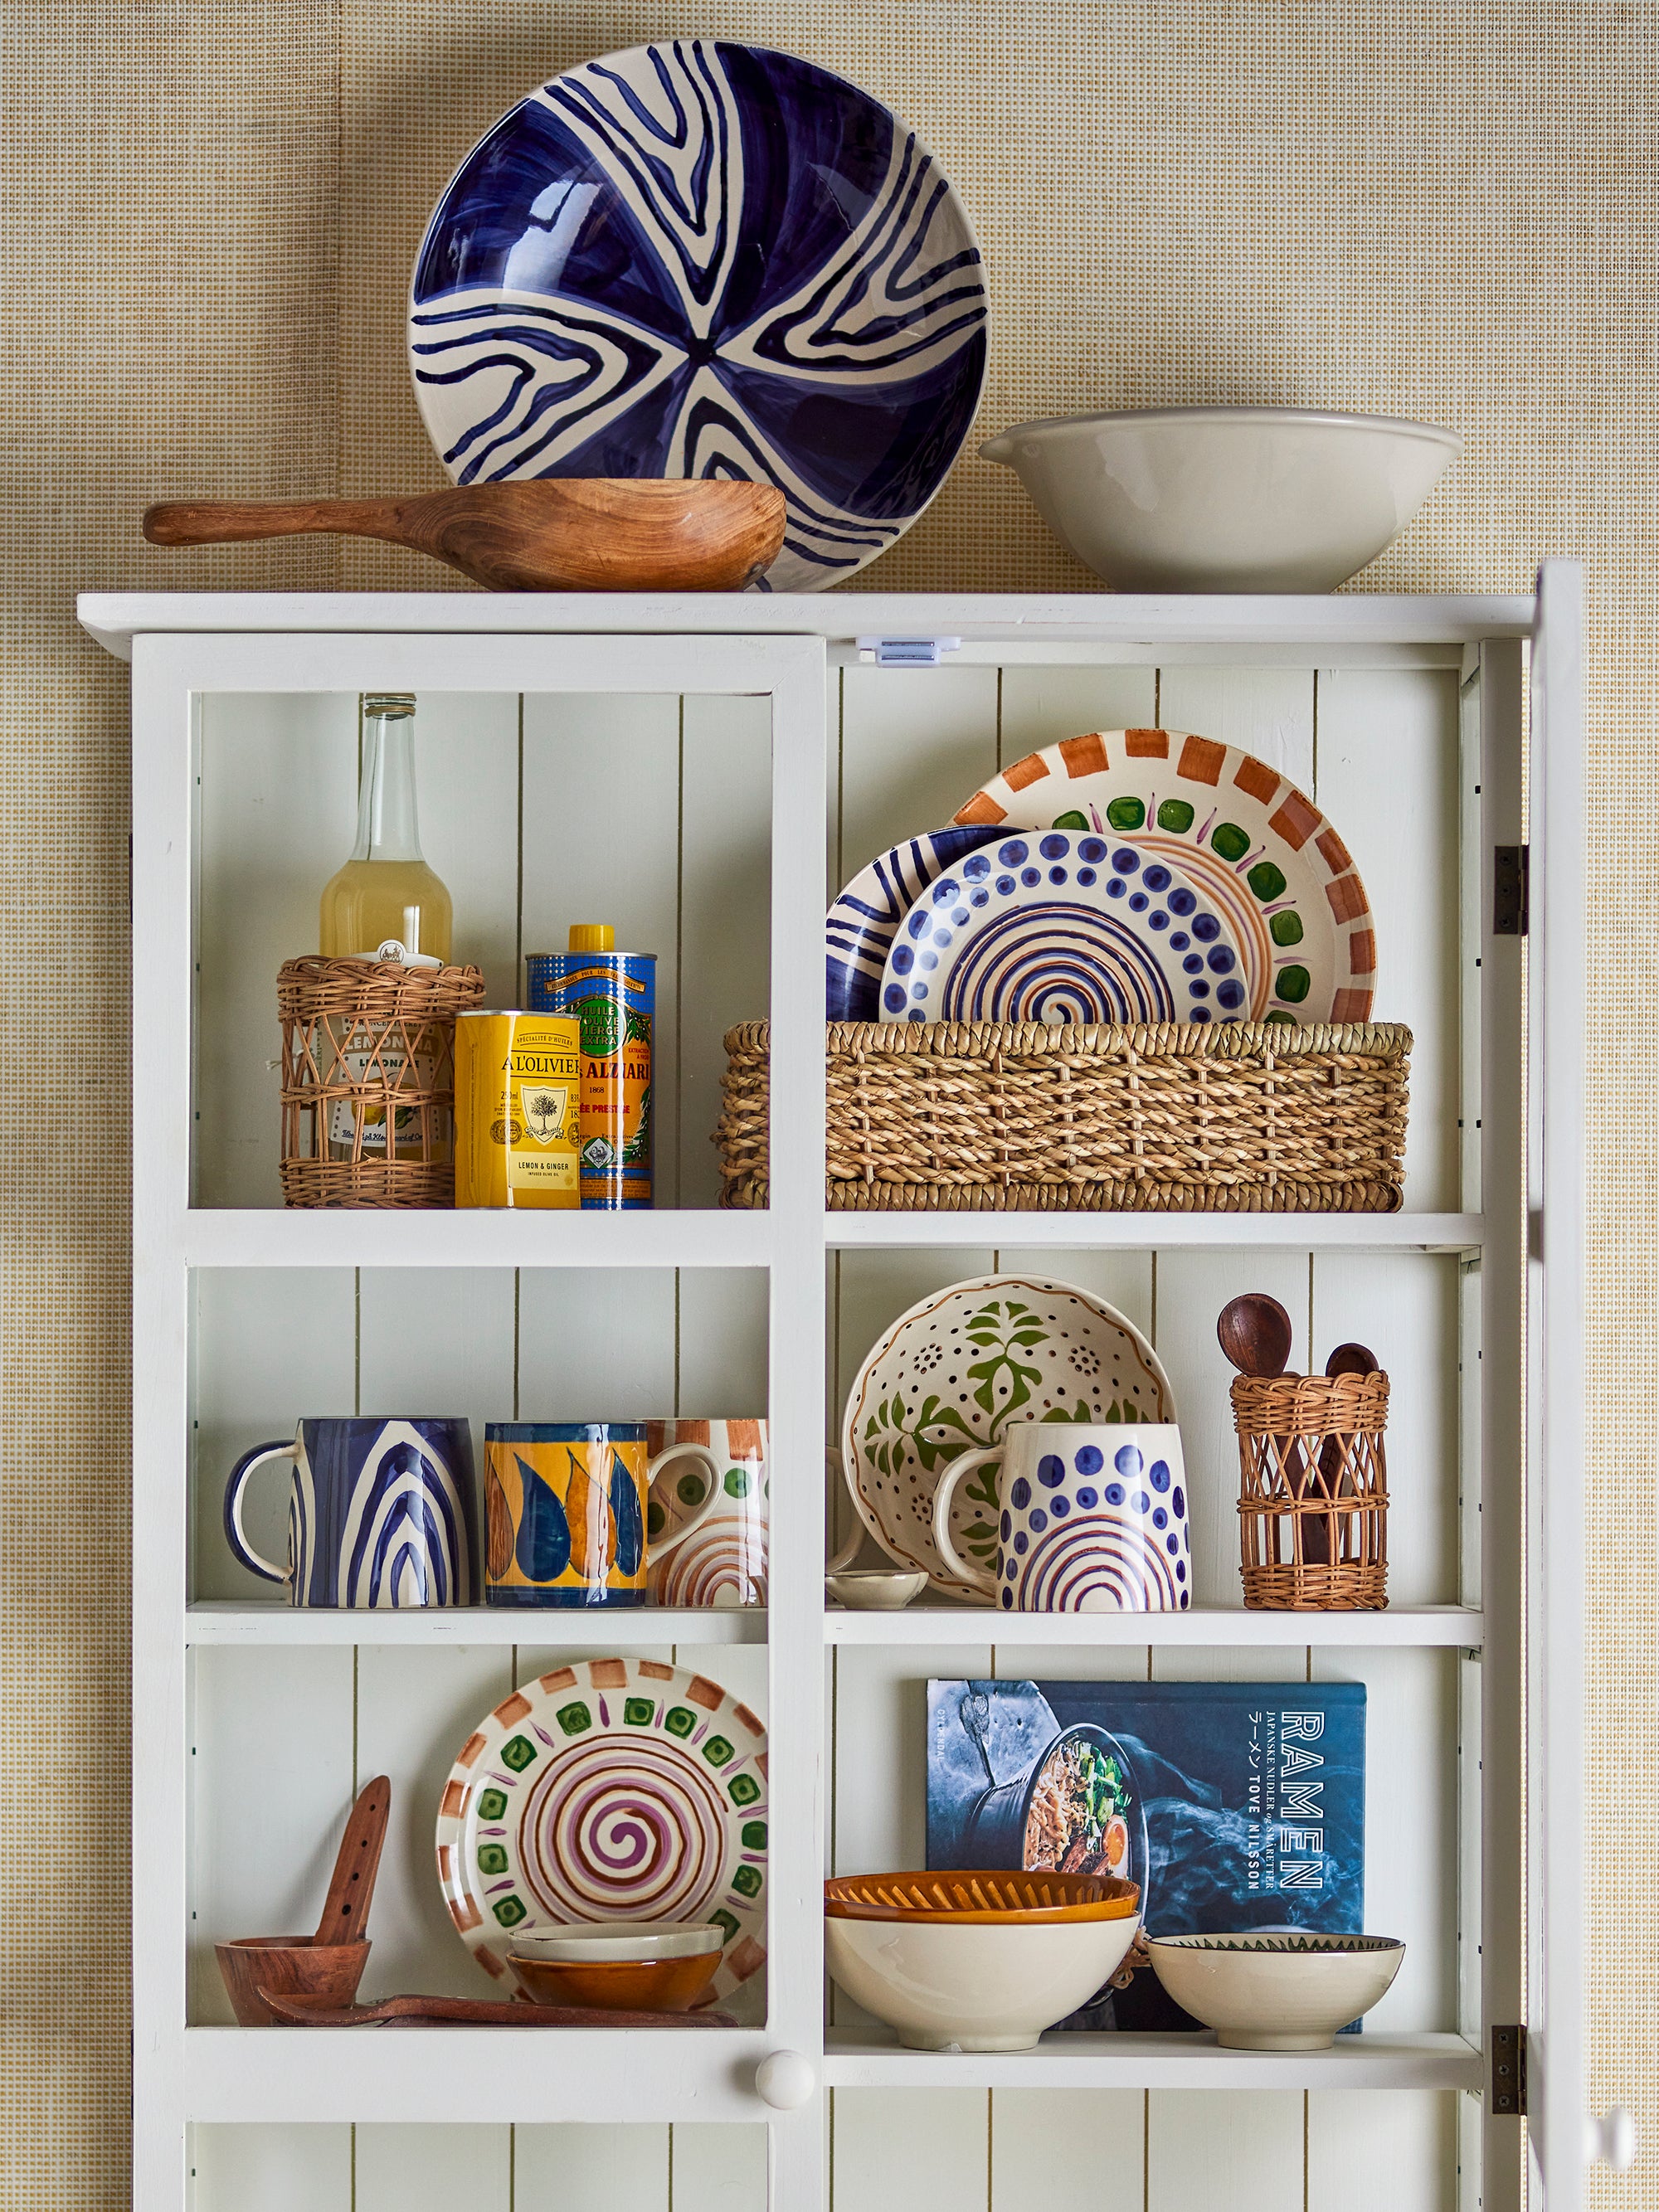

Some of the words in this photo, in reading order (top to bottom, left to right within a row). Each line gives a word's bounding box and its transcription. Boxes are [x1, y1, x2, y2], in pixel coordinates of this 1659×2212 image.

[581, 1006, 615, 1016] HUILE
[581, 1016, 620, 1026] 'OLIVE
[517, 1035, 547, 1044] SPÉCIALITÉ
[547, 1035, 573, 1047] D'HUILES
[581, 1036, 617, 1046] EXTRA
[589, 1086, 605, 1094] 1868
[591, 1104, 630, 1114] PRESTGE
[518, 1161, 538, 1169] LEMON
[546, 1162, 569, 1170] GINGER
[1248, 1711, 1262, 1769] ラーメン
[1266, 1710, 1277, 1764] JAPANSKE
[1248, 1775, 1261, 1813] TOVE
[1266, 1767, 1276, 1811] NUDLER
[1280, 1711, 1325, 1889] RAMEN
[1263, 1812, 1272, 1825] og
[1248, 1824, 1260, 1889] NILSSON
[1265, 1826, 1277, 1889] SMÅRETTER
